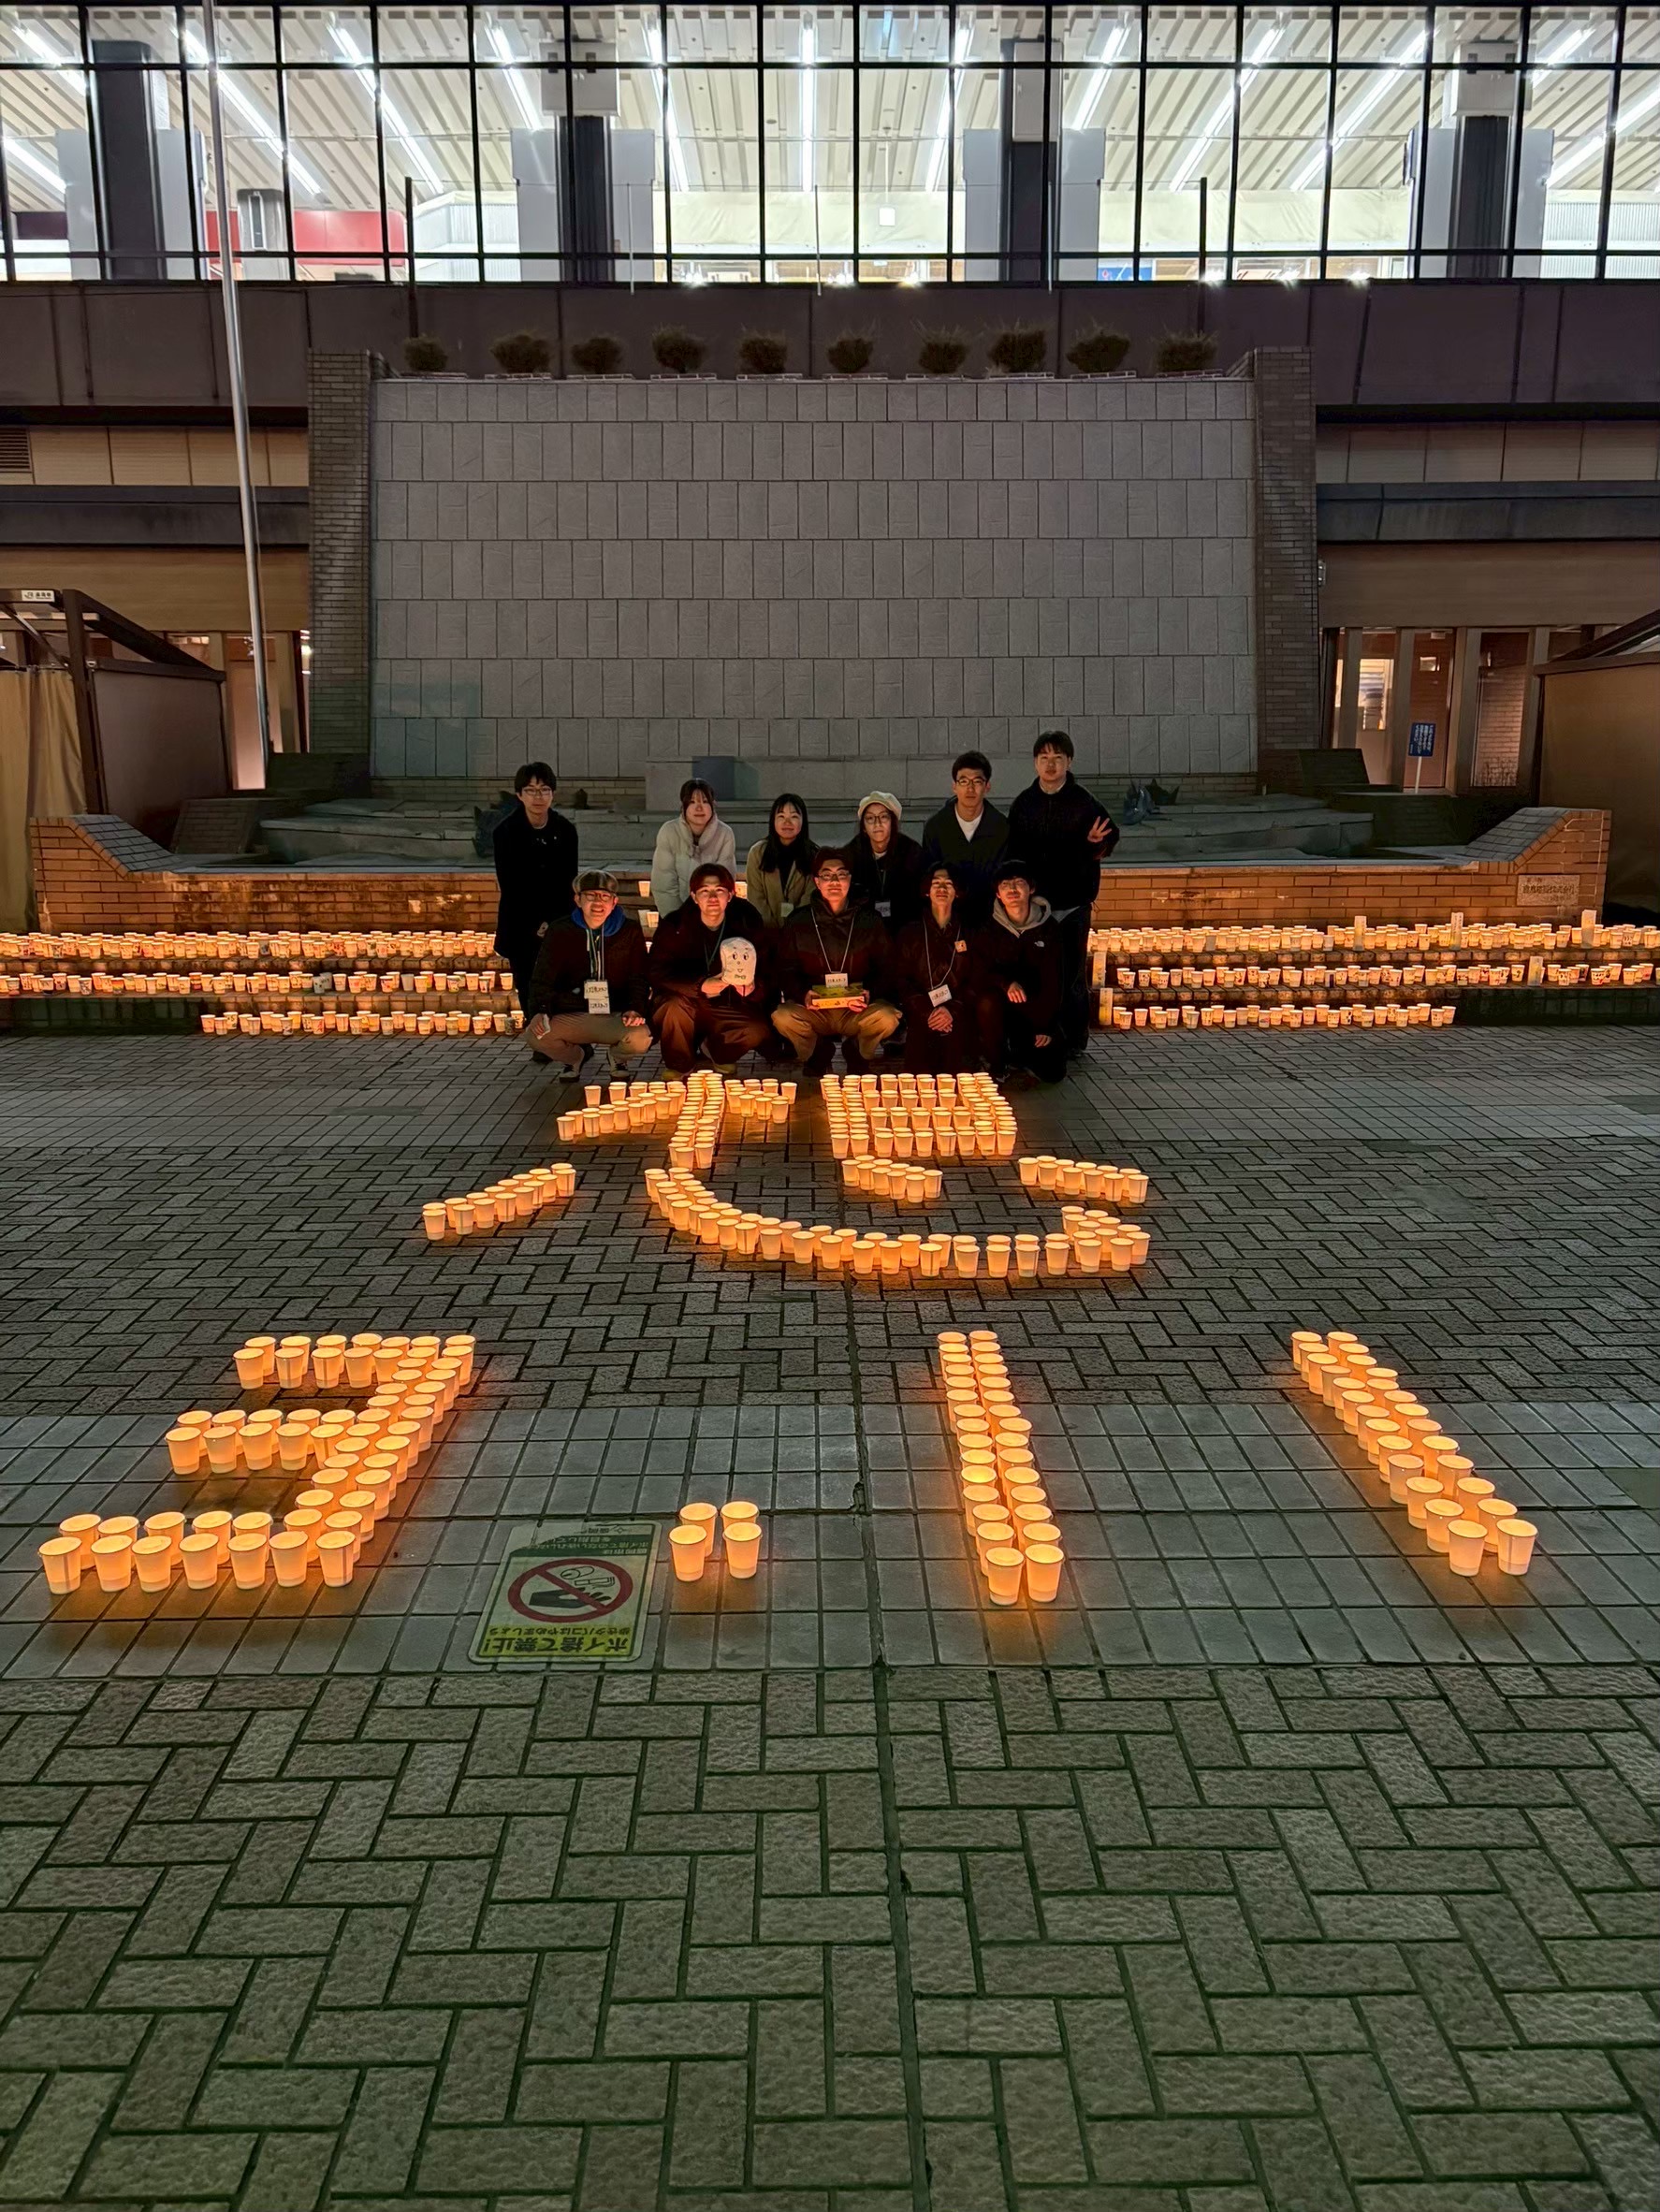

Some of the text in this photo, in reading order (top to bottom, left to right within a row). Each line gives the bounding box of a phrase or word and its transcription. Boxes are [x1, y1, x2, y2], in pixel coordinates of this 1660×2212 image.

[422, 1070, 1150, 1279] 想
[488, 1627, 631, 1637] 歩きタバコはやめましょう
[483, 1637, 629, 1653] ポイ捨て禁止!
